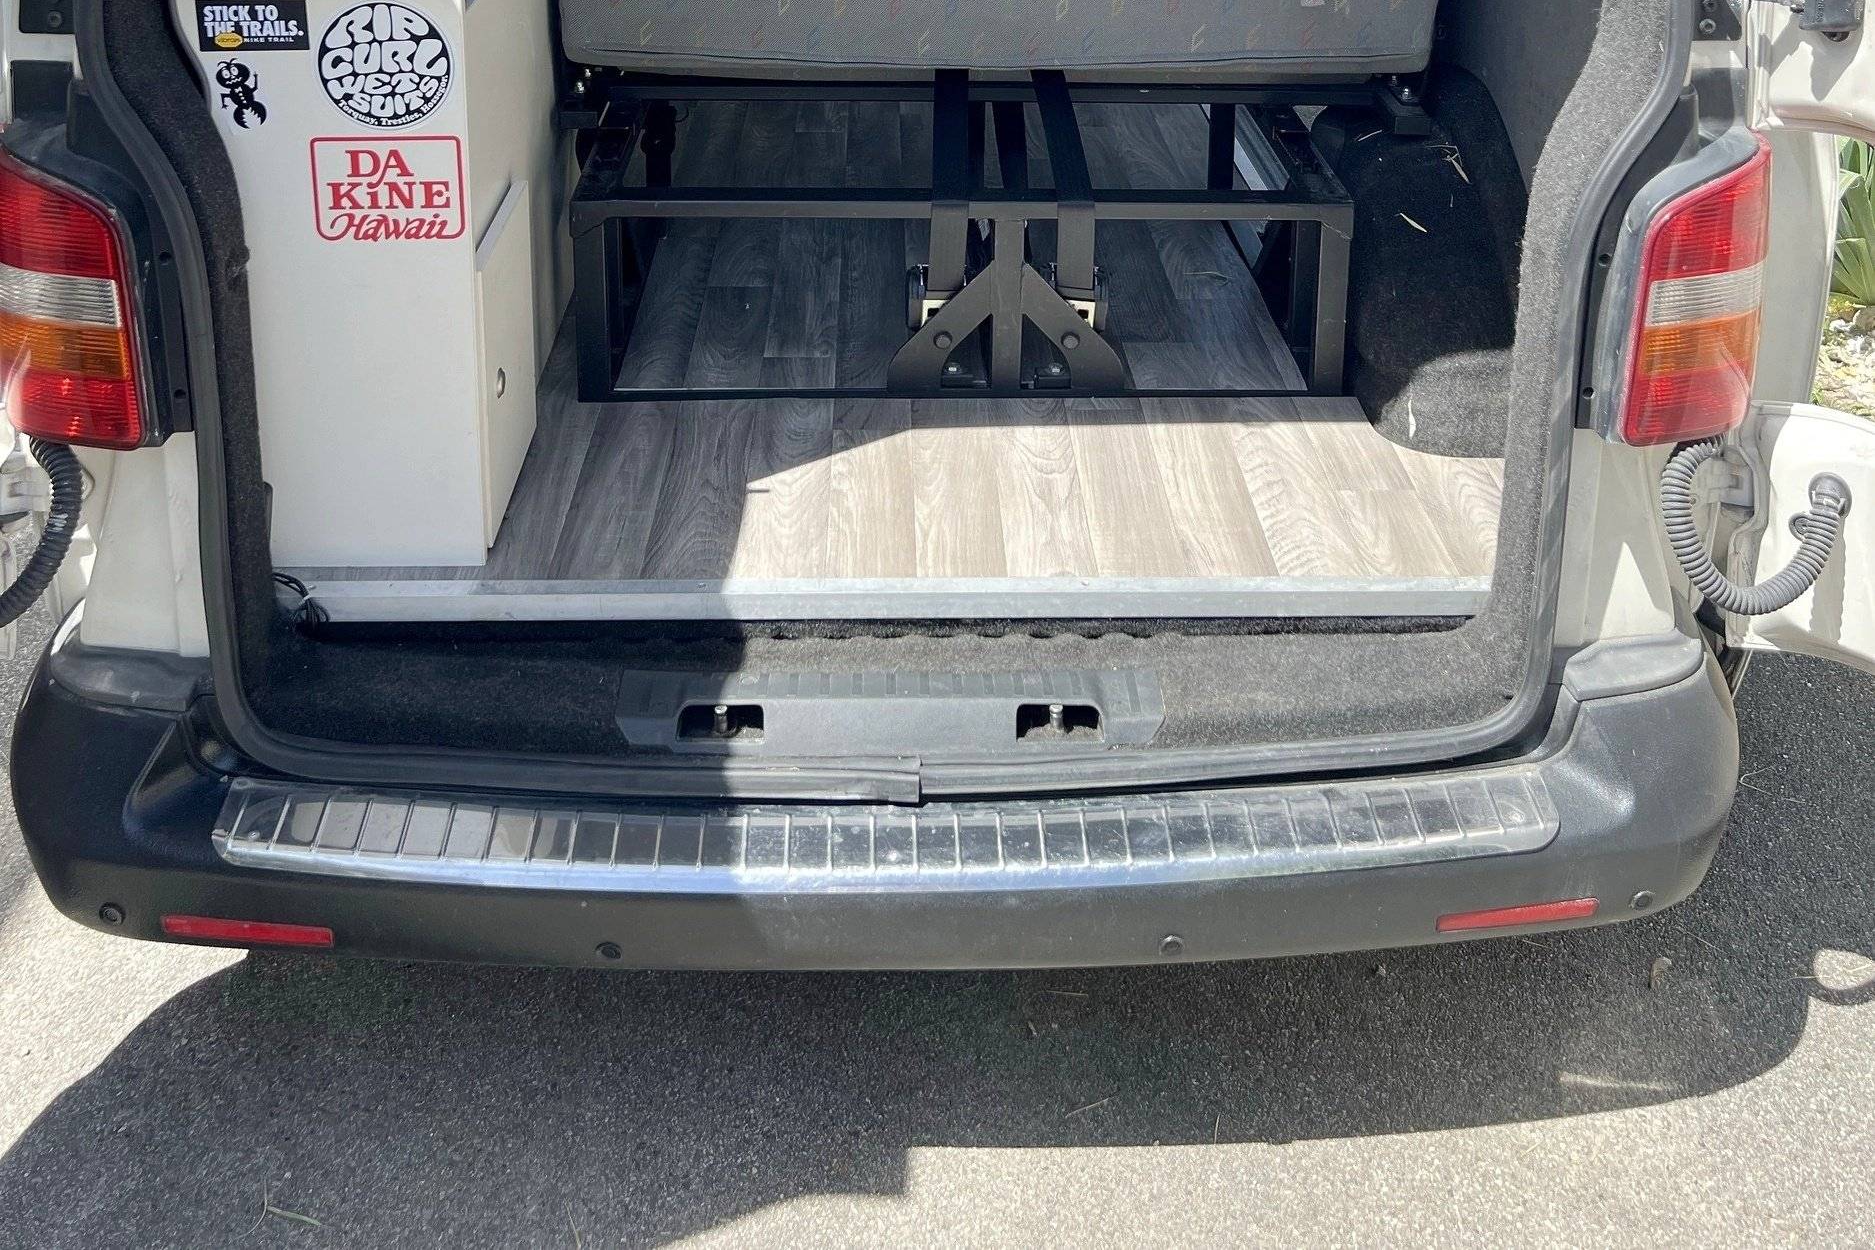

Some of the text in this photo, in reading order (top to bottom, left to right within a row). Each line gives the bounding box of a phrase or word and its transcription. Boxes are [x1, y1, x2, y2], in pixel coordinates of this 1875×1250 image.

[203, 5, 279, 22] STICK TO
[204, 20, 304, 37] THE TRAILS.
[325, 3, 430, 49] RIP
[321, 38, 448, 80] CURL
[345, 149, 414, 189] DA
[330, 213, 450, 242] Hawaii
